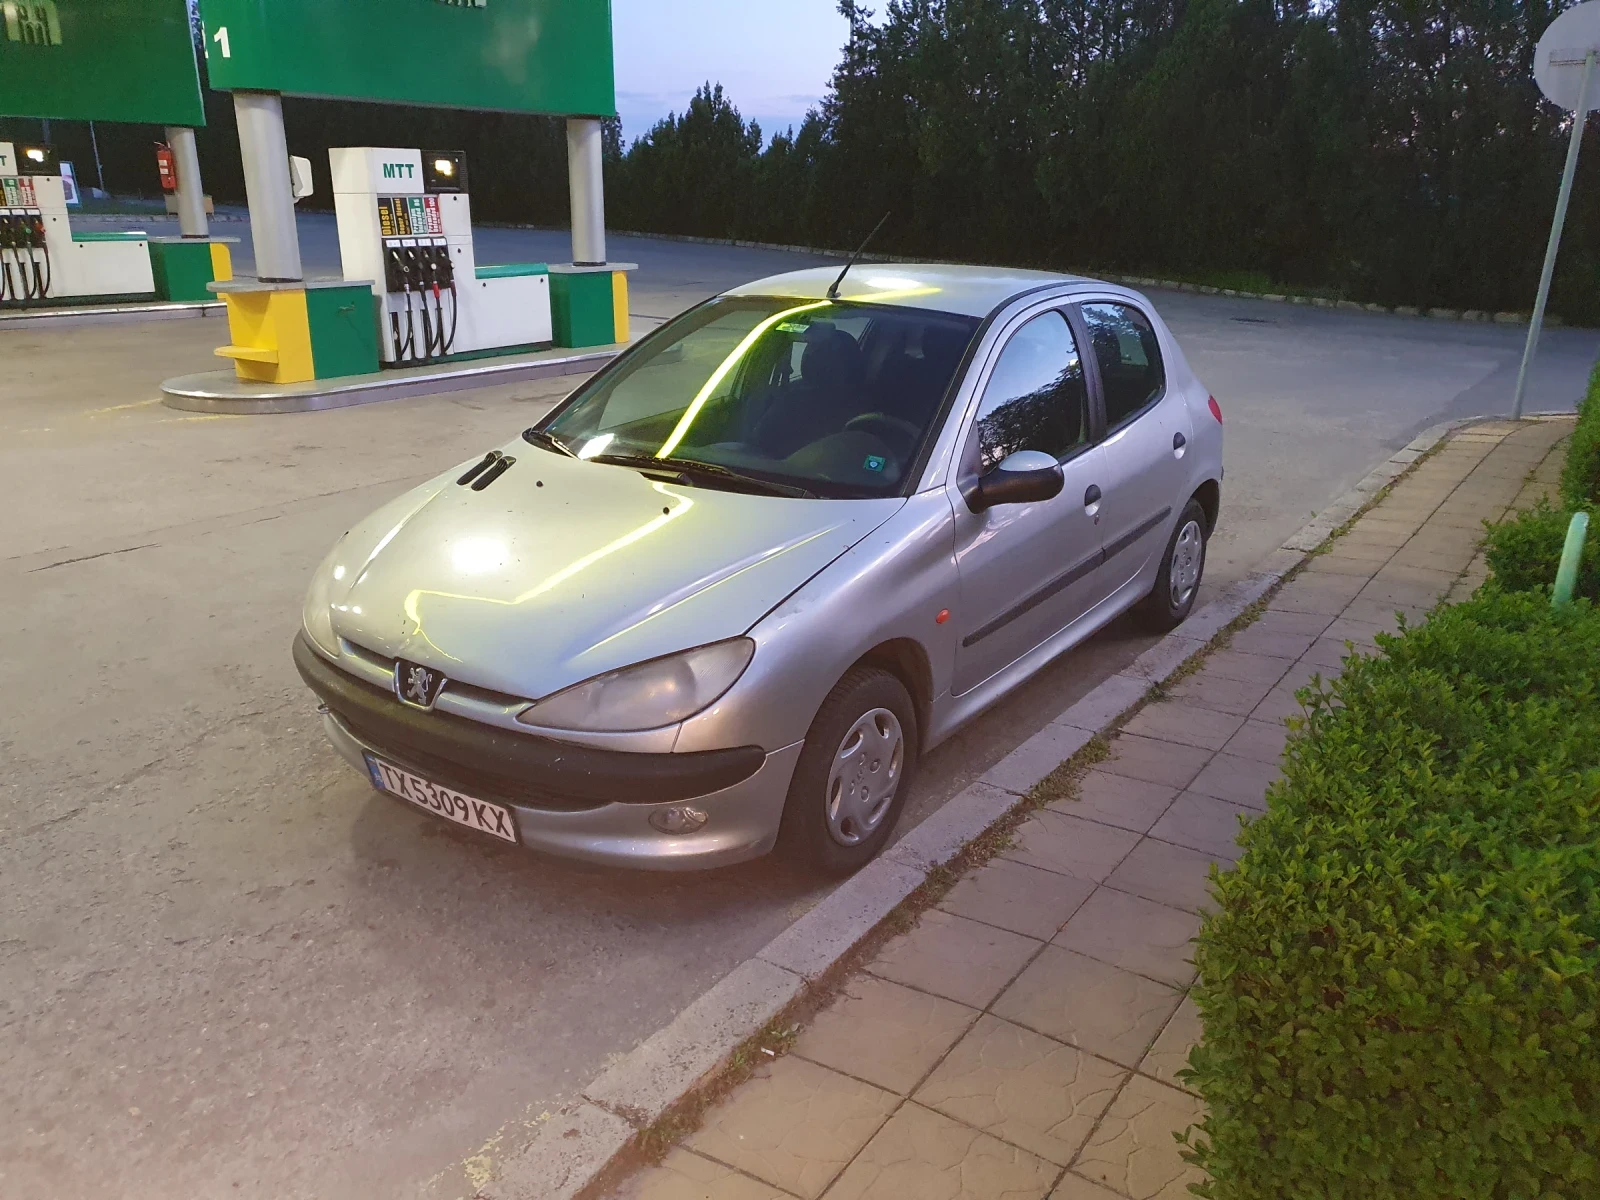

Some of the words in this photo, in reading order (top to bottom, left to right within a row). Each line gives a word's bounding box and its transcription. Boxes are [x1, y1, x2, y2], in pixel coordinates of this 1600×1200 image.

[214, 27, 230, 57] 1
[383, 163, 414, 178] MTT
[378, 206, 392, 235] Diesel
[394, 198, 403, 217] Diesel
[379, 763, 511, 838] TX5309KX
